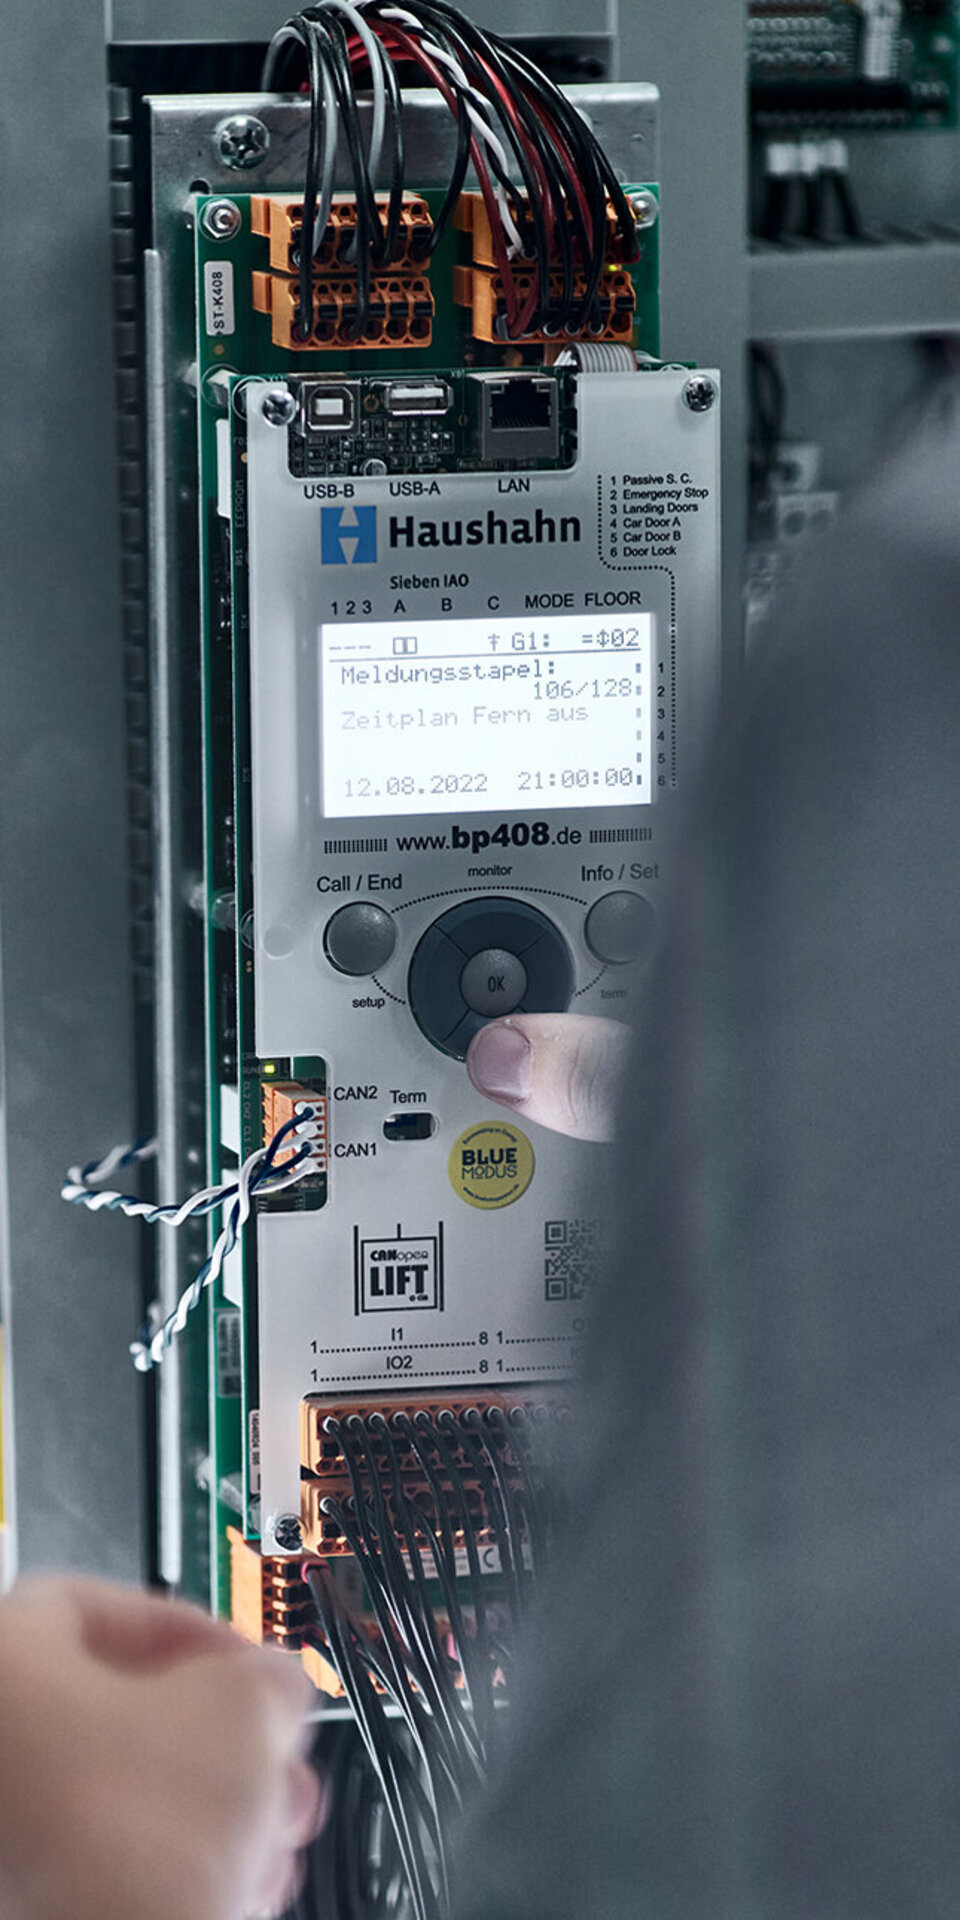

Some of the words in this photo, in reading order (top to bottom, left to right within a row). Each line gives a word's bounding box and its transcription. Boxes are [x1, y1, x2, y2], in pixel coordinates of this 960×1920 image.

[211, 271, 225, 330] ST-K408
[498, 478, 530, 493] LAN
[610, 476, 617, 485] 1
[623, 475, 664, 485] Passive
[304, 483, 354, 499] USB-B
[390, 481, 441, 496] USB-A
[609, 490, 618, 500] 2
[623, 489, 682, 501] Emergency
[684, 487, 709, 499] Stop
[609, 504, 618, 515] 3
[623, 503, 664, 515] Landing
[667, 502, 698, 513] Doors
[390, 509, 580, 548] Haushahn
[609, 519, 618, 528] 4
[623, 518, 642, 529] Car
[645, 517, 670, 528] Door
[671, 516, 682, 527] A
[609, 533, 618, 543] 5
[623, 532, 642, 543] Car
[645, 531, 670, 542] Door
[672, 530, 682, 541] B
[609, 547, 618, 557] 6
[623, 547, 649, 557] Door
[652, 545, 676, 556] Lock
[390, 575, 439, 590] Sieben
[444, 574, 469, 587] IAO
[330, 602, 338, 615] 1
[345, 601, 357, 615] 2
[362, 600, 373, 614] 3
[393, 599, 407, 613] A
[441, 598, 453, 611] B
[487, 596, 500, 610] C
[525, 593, 574, 608] MODE
[585, 591, 641, 606] FLOOR
[341, 659, 554, 685] Meldungsstapel:
[658, 662, 664, 673] 1
[534, 676, 631, 700] 106/128
[657, 686, 666, 697] 2
[342, 708, 457, 730] Zeitplan
[474, 706, 530, 724] Fern
[547, 707, 588, 721] aus
[657, 708, 666, 720] 3
[656, 731, 666, 741] 4
[657, 754, 667, 764] 5
[346, 774, 487, 797] 12.08.2022
[518, 768, 633, 790] 21:00:00
[657, 776, 667, 786] 6
[396, 822, 582, 854] www.bp408.de
[468, 865, 512, 877] monitor
[582, 865, 613, 881] Info
[630, 863, 660, 880] Set
[317, 875, 350, 892] Call
[368, 873, 402, 890] End
[488, 976, 505, 993] OK
[352, 997, 385, 1009] setup
[334, 1085, 377, 1101] CAN2
[390, 1090, 426, 1103] Term
[334, 1143, 376, 1158] CAN1
[462, 1148, 518, 1166] BLUE
[461, 1165, 518, 1180] MODUS
[370, 1264, 429, 1296] LIFT
[310, 1341, 317, 1353] 1
[478, 1331, 489, 1345] 8
[496, 1331, 503, 1344] 1
[387, 1355, 412, 1370] IO2
[310, 1369, 318, 1382] 1
[478, 1360, 490, 1374] 8
[496, 1359, 503, 1372] 1
